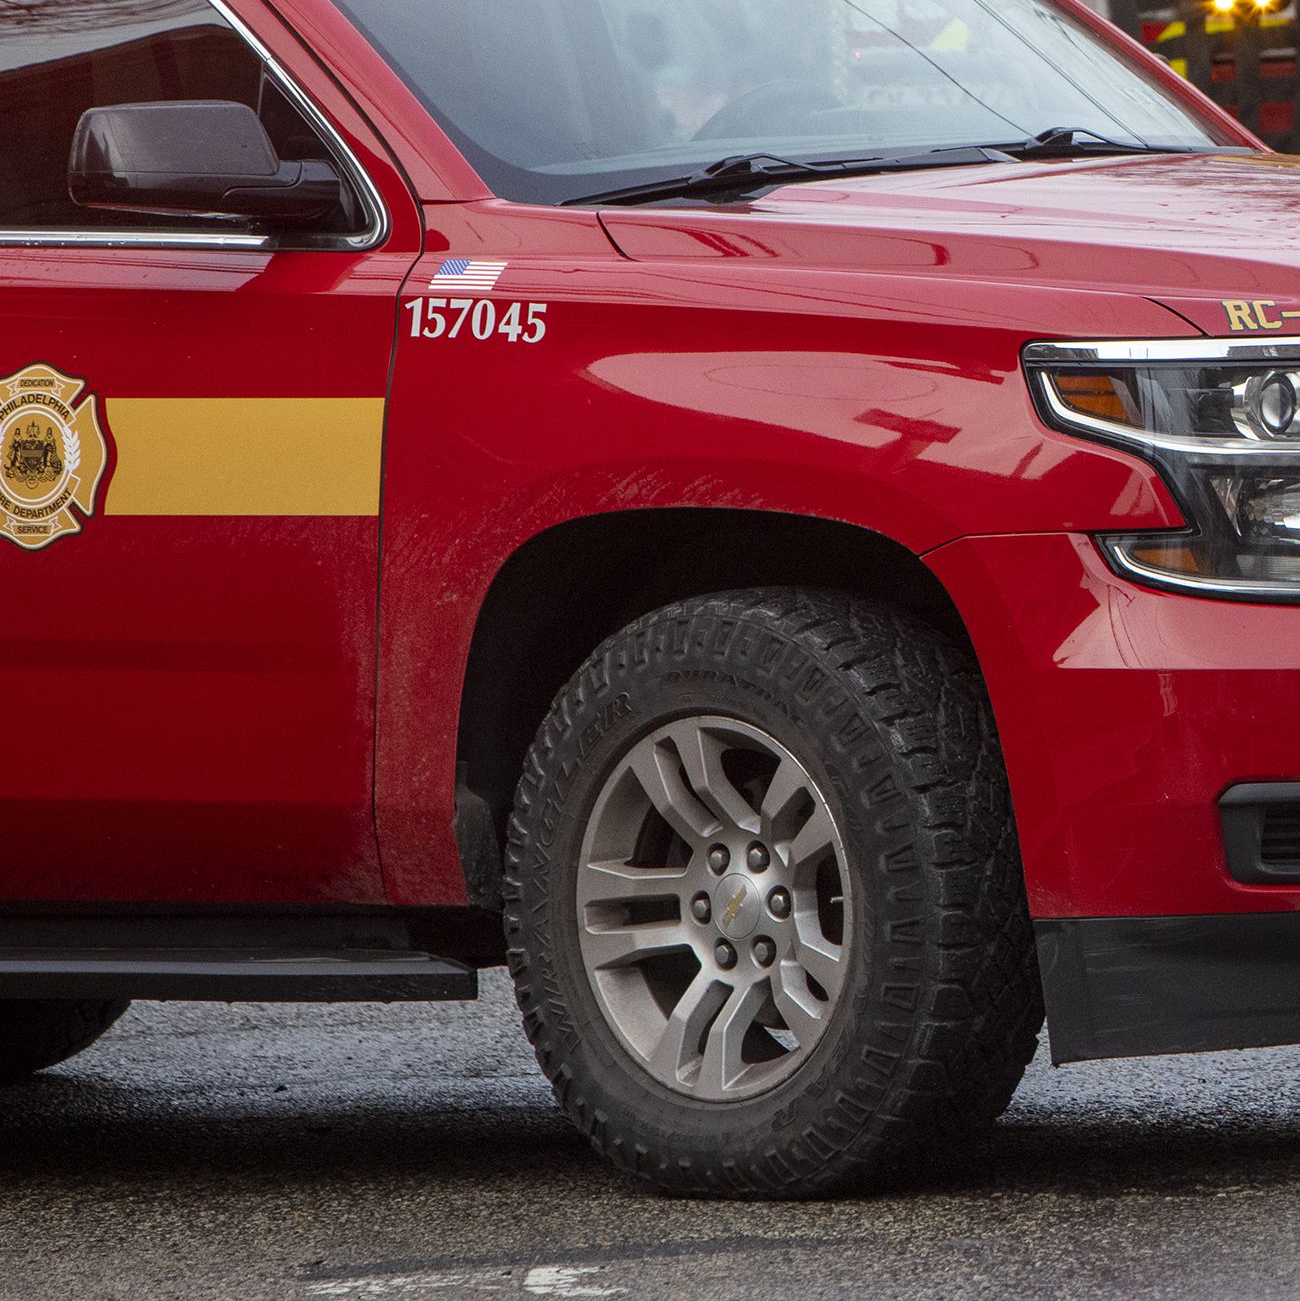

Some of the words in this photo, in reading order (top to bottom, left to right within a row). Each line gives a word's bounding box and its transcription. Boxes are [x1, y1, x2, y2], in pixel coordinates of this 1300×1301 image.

[404, 296, 548, 344] 157045
[19, 378, 55, 388] DEDICATION
[0, 393, 70, 421] PHILADELPHIA
[13, 488, 72, 519] DEPARTMENT
[16, 525, 49, 535] SERVICE
